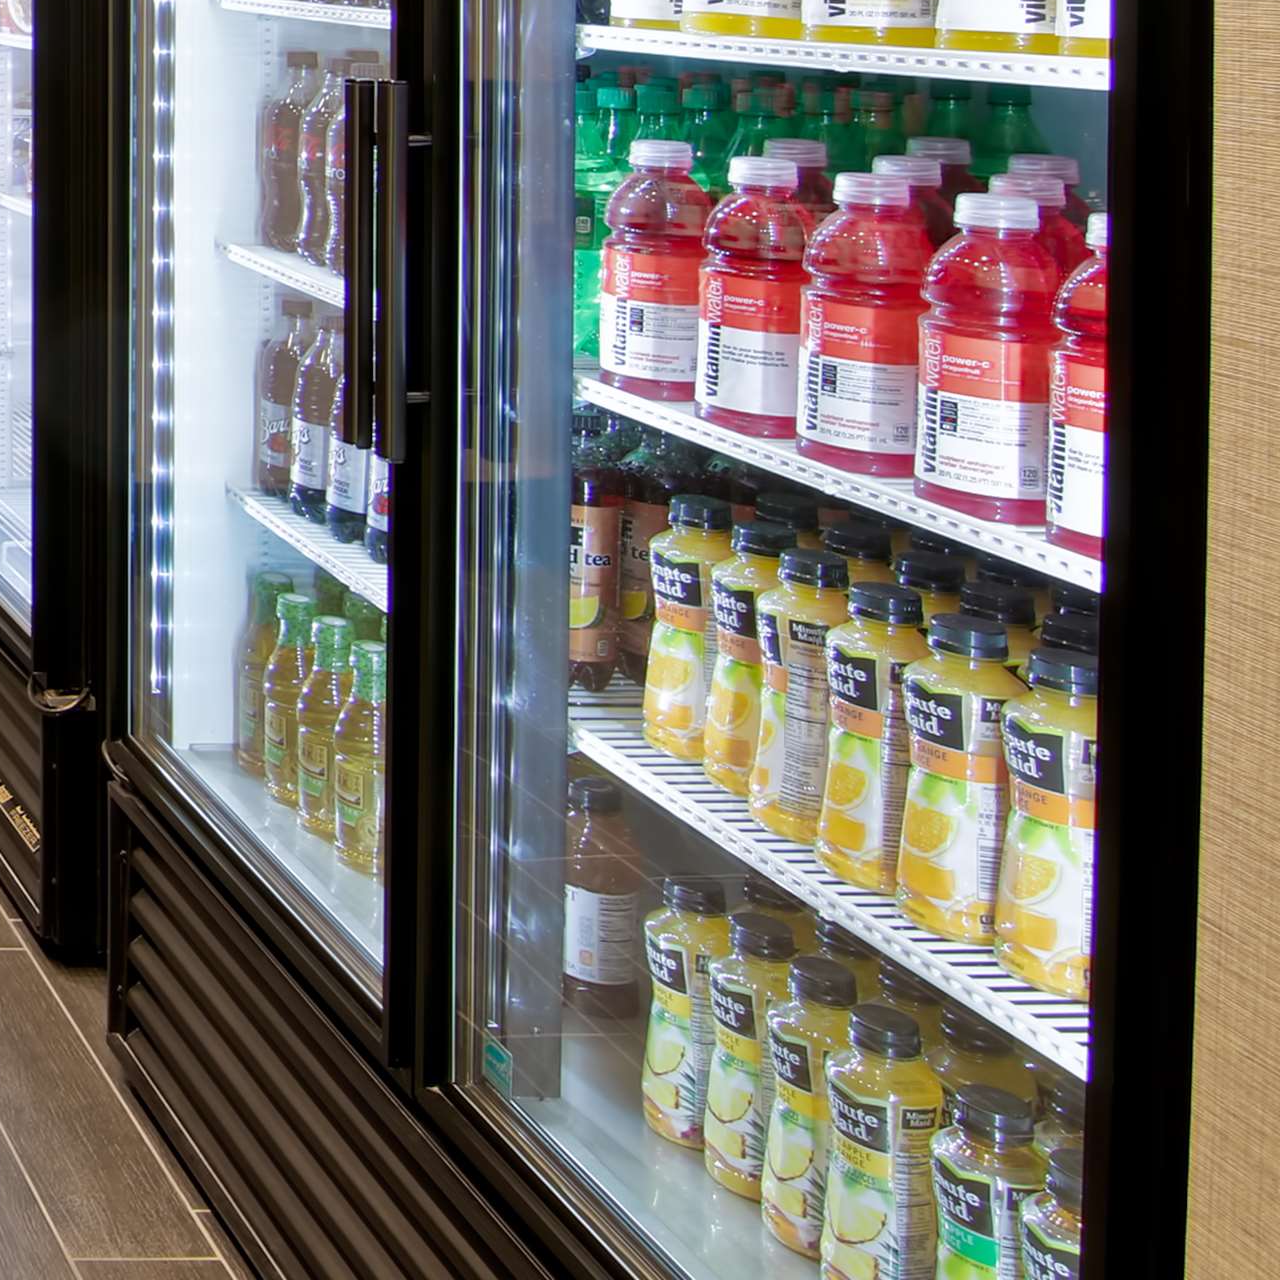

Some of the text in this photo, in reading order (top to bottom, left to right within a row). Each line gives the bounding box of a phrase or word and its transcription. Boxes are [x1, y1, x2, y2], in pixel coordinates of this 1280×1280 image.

[723, 294, 765, 307] power-c
[612, 297, 628, 366] vitamin
[823, 321, 868, 335] power-c
[704, 321, 721, 397] vitamin
[942, 354, 990, 369] power-c
[805, 351, 821, 431] vitamin
[1067, 386, 1104, 400] power-
[923, 385, 939, 473] vitamin
[1023, 468, 1038, 479] 120
[584, 552, 612, 567] tea
[631, 546, 648, 561] te
[715, 608, 740, 628] aid
[792, 623, 826, 636] Minut
[829, 677, 857, 699] aid
[908, 713, 942, 737] aid
[1008, 733, 1052, 761] ute
[1009, 753, 1040, 779] aid
[713, 1008, 739, 1029] aid
[833, 1112, 871, 1144] aid
[939, 1199, 973, 1225] aid
